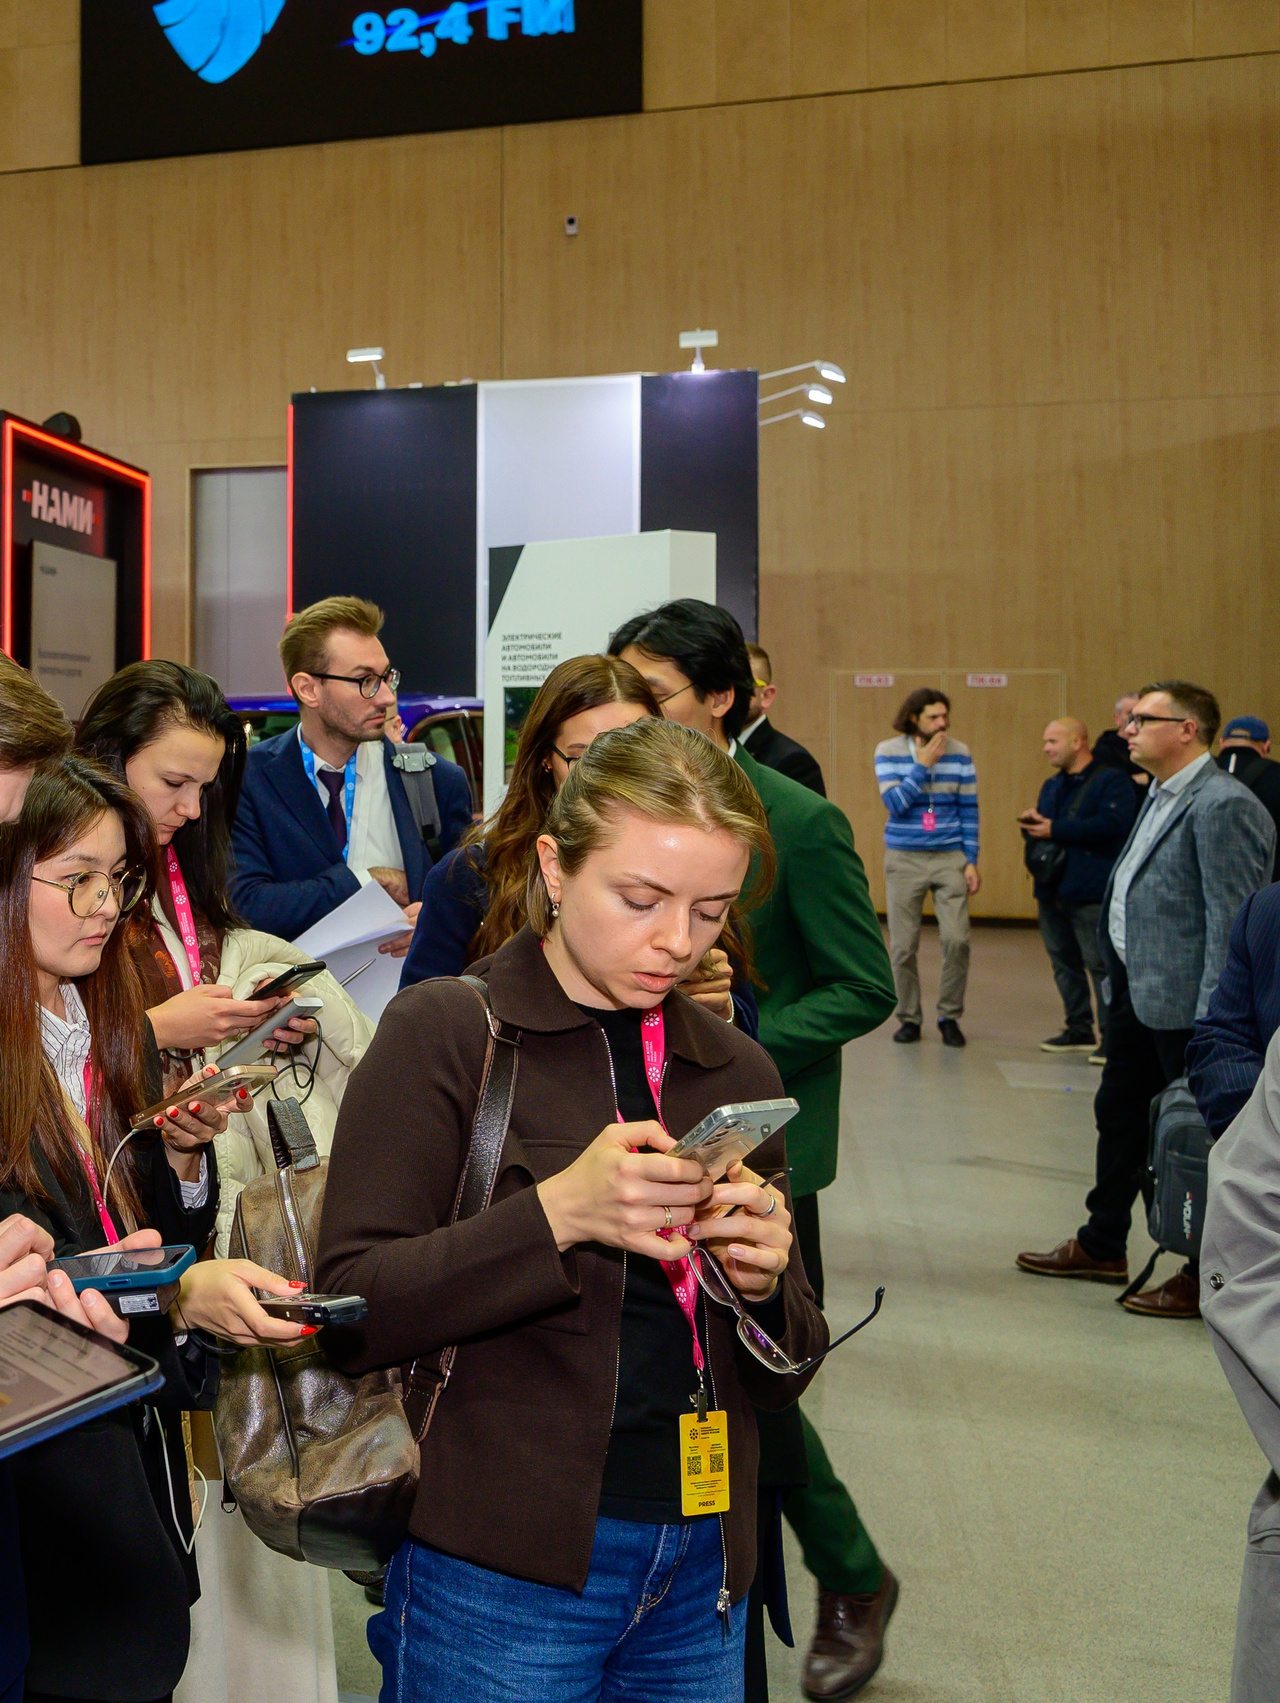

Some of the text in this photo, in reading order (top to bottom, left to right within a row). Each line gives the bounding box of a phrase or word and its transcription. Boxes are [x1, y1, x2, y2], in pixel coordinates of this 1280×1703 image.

[352, 0, 575, 57] 92,4 FM
[502, 632, 562, 641] ЭЛЕКТРИЧЕСКИЕ
[502, 643, 551, 651] АВТОМОБИЛИ
[508, 653, 558, 661] АВТОМОБИЛИ
[698, 1500, 716, 1508] PRESS
